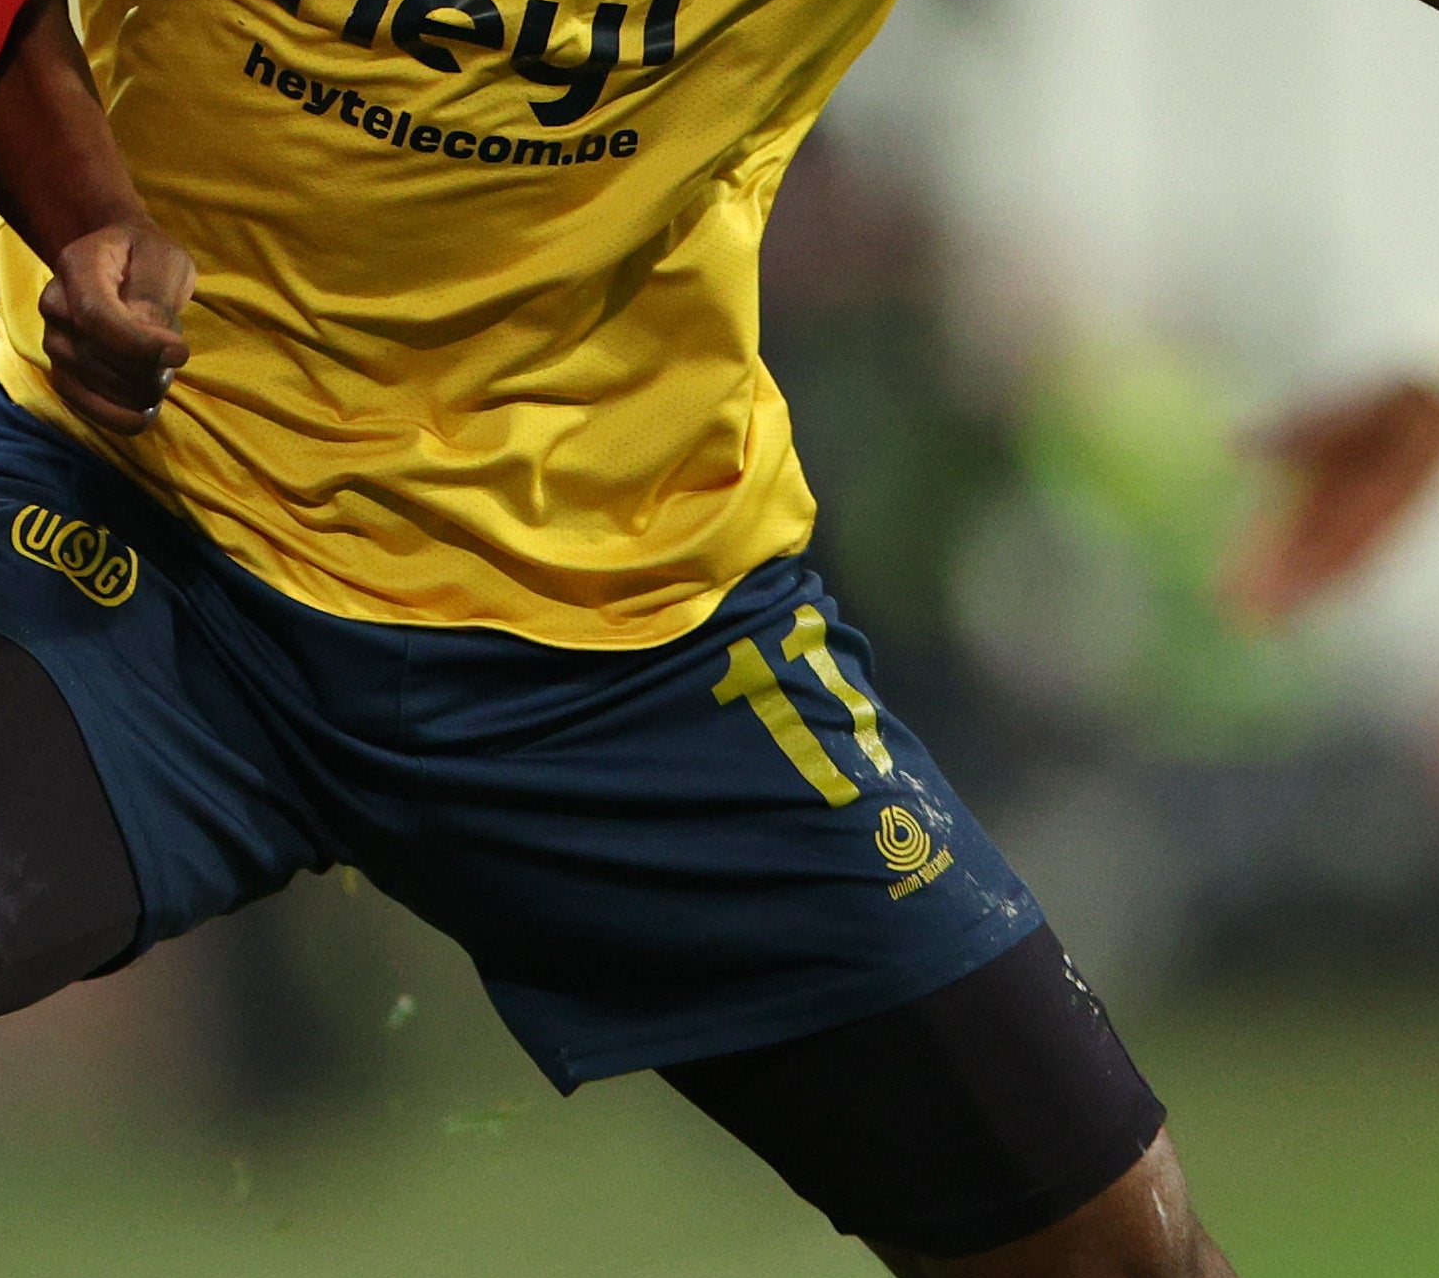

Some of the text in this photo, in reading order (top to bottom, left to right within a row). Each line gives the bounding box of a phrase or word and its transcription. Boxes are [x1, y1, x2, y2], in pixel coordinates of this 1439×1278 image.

[242, 41, 639, 167] heytelecom.be
[25, 507, 129, 596] USG
[710, 602, 894, 810] 11
[887, 873, 923, 901] union
